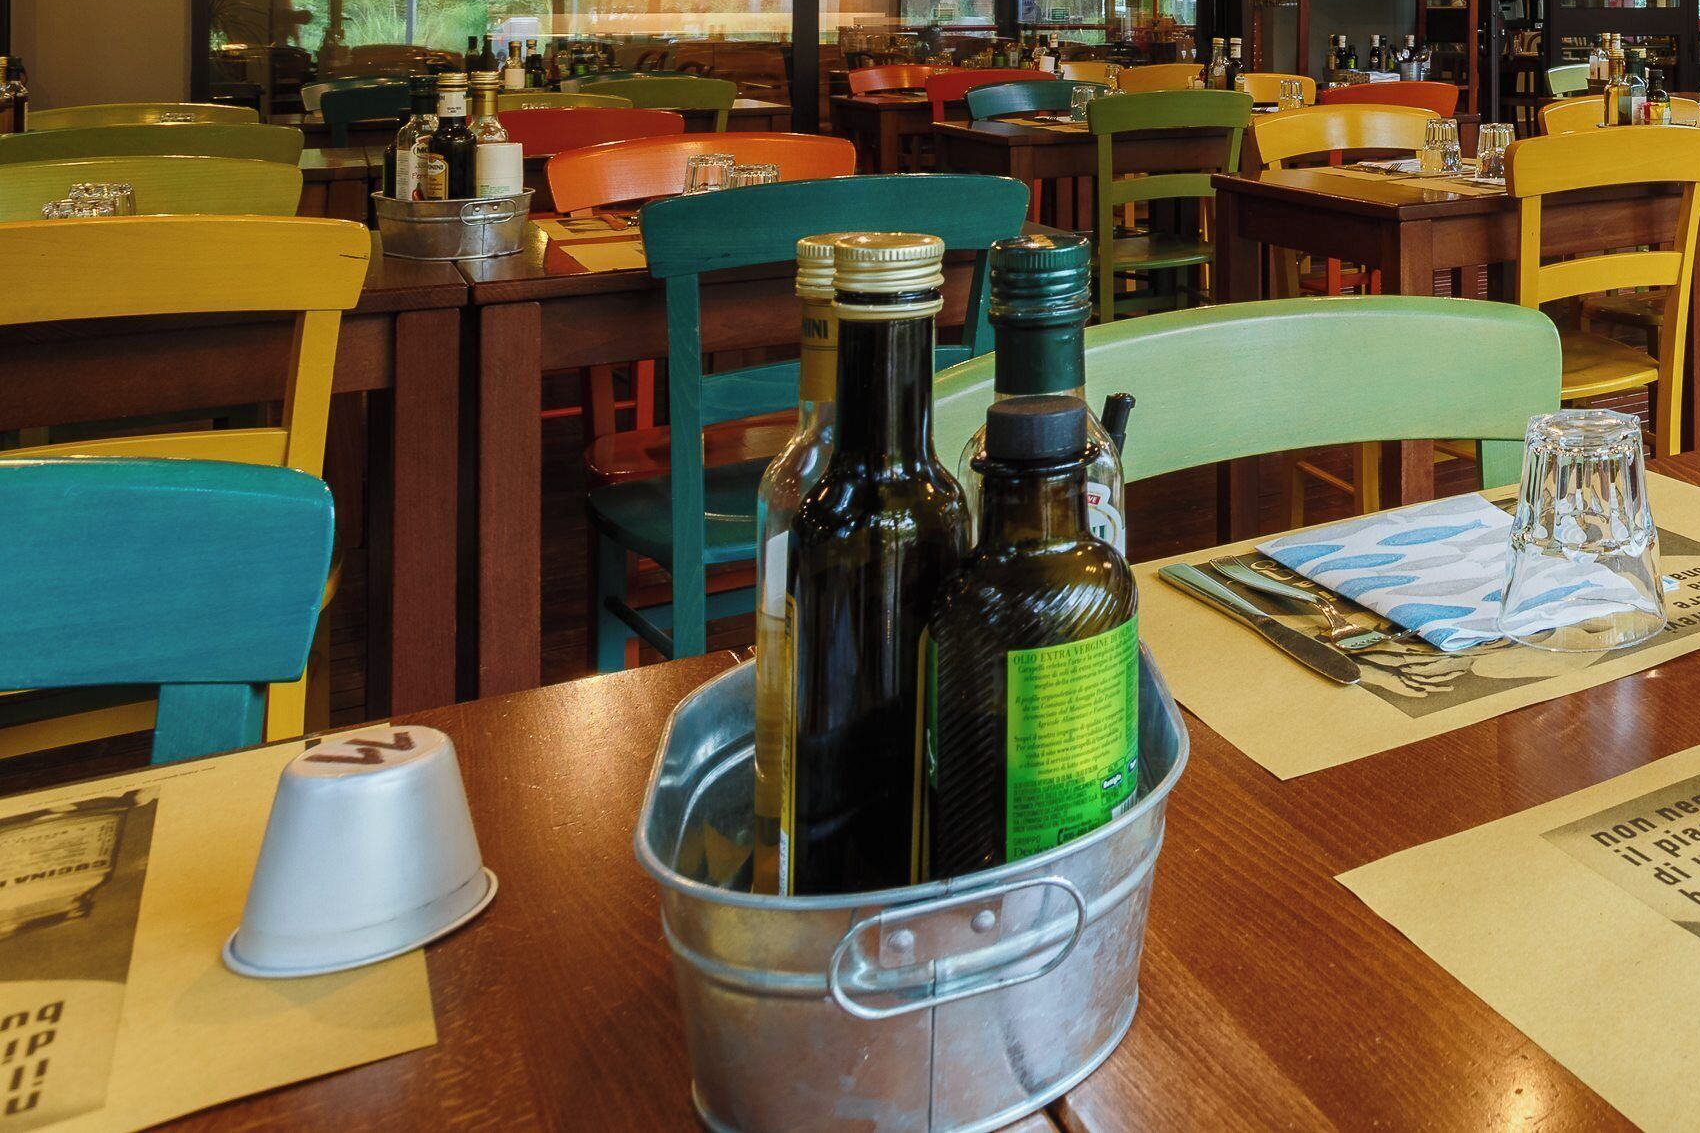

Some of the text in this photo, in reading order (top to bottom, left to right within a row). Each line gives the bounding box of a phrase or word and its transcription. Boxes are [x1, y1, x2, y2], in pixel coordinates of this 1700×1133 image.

[1013, 653, 1036, 665] OLIO
[1040, 646, 1070, 662] EXTRA
[1073, 636, 1107, 655] VERGINE
[1590, 817, 1658, 848] non
[1613, 846, 1653, 867] il
[14, 859, 107, 884] CUCINA
[1653, 862, 1692, 886] di
